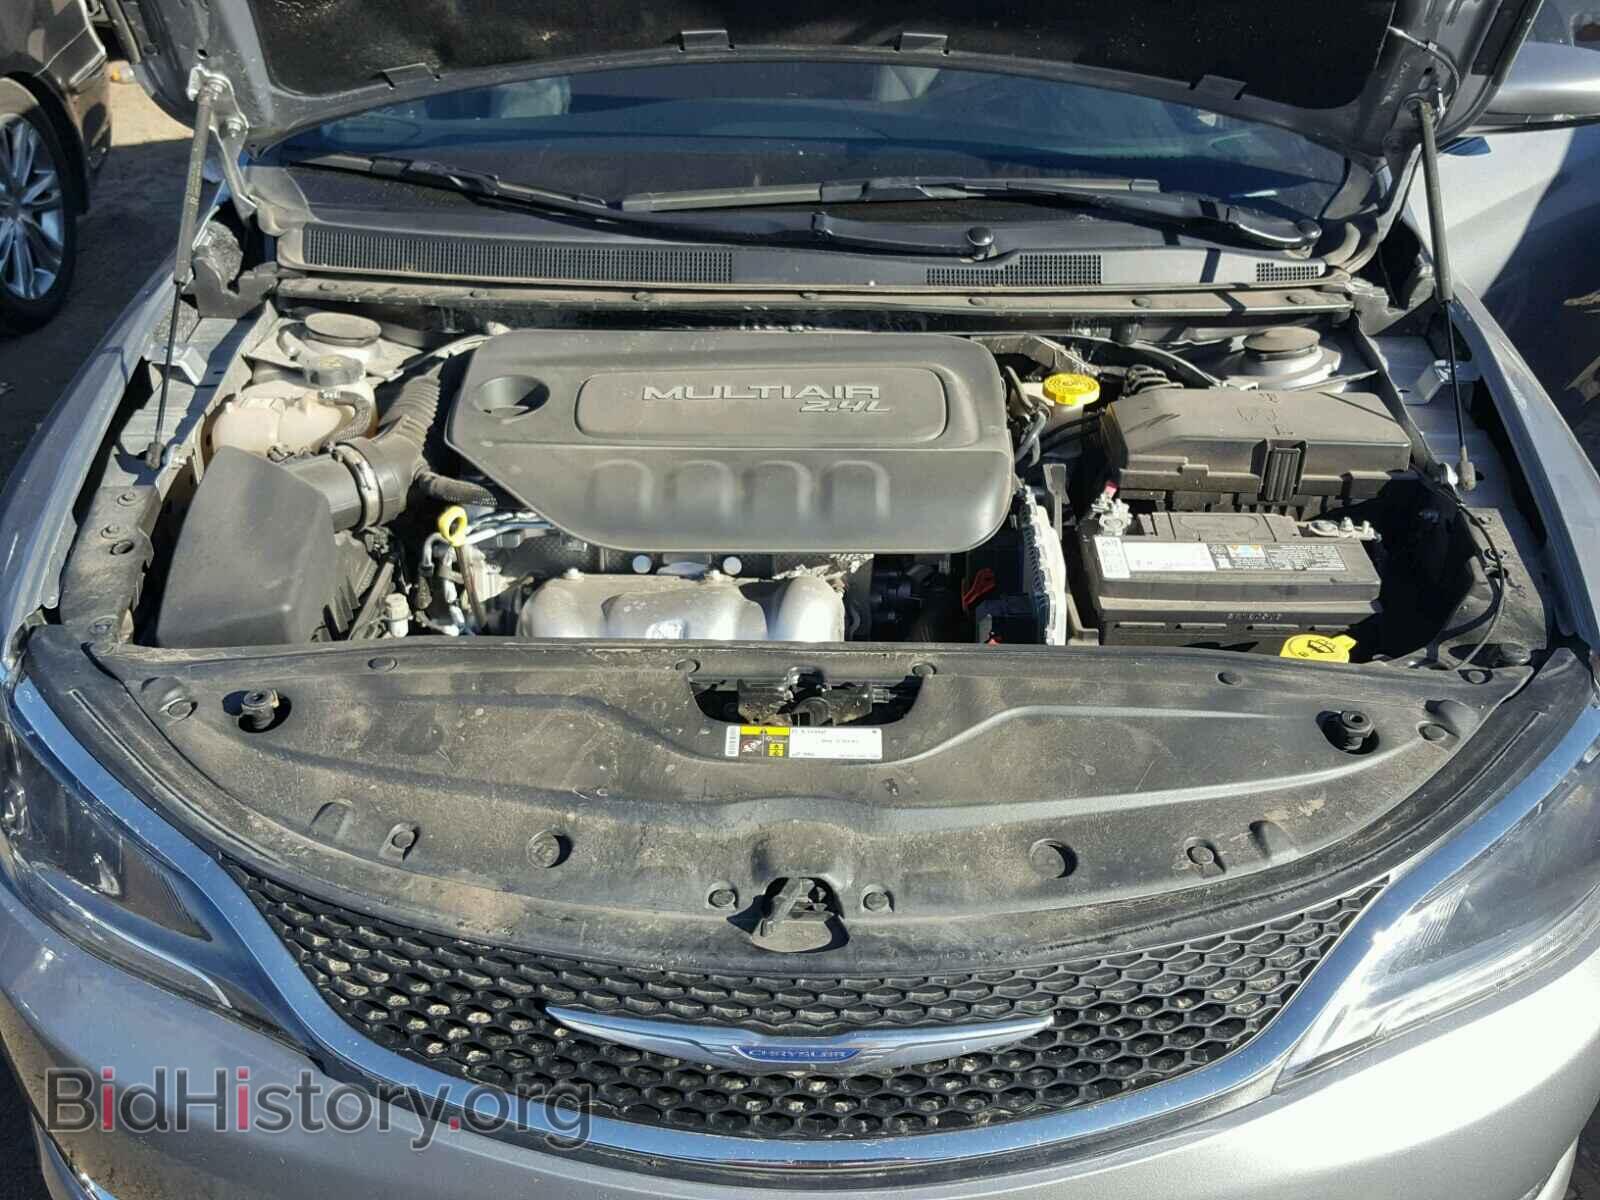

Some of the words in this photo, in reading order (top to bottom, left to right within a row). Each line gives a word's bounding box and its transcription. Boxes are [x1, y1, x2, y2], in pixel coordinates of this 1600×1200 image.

[642, 385, 881, 400] MULTIAIR
[800, 400, 891, 413] 2.4L
[749, 1048, 845, 1058] CHRYSLER
